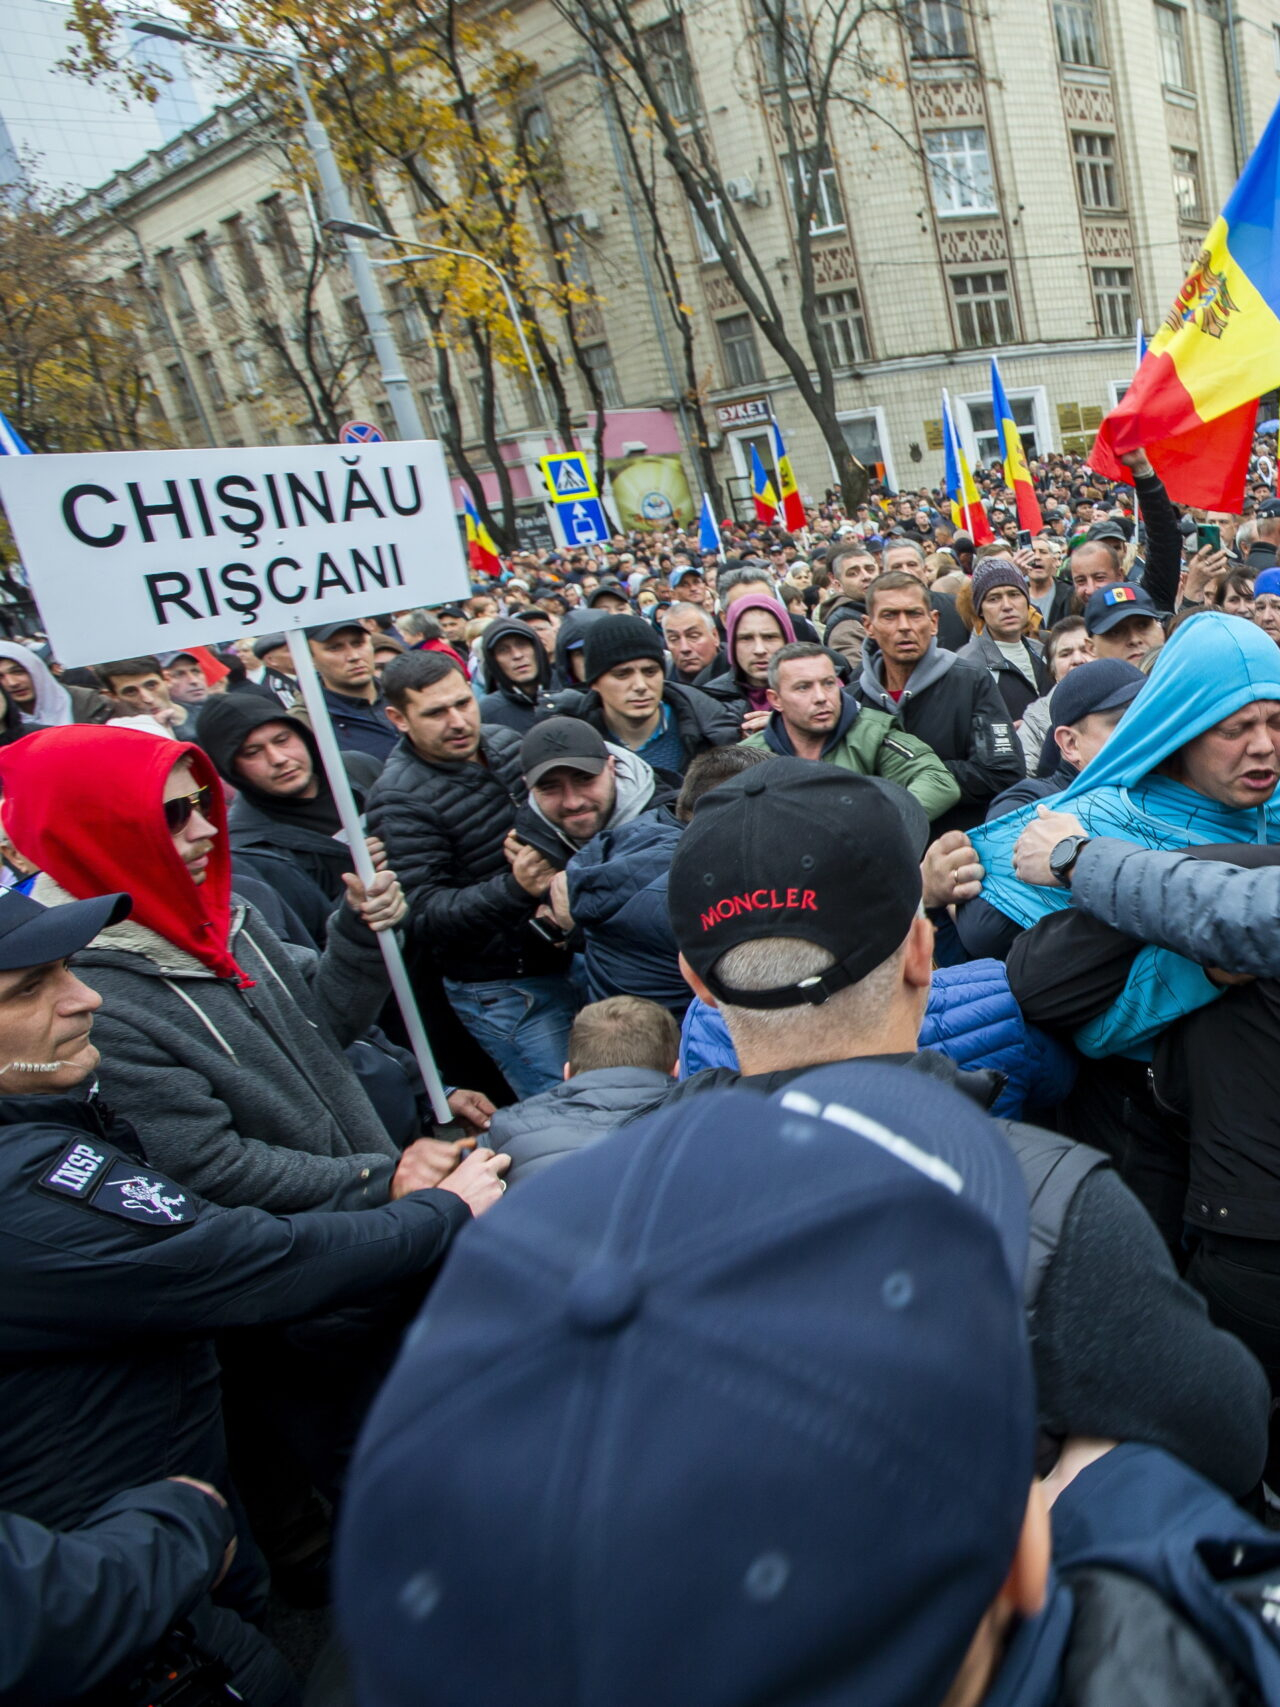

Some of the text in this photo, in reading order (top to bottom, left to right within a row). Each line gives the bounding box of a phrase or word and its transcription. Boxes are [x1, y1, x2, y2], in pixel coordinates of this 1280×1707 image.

[717, 400, 767, 421] БУКЕТ
[700, 887, 819, 932] MONCLER
[50, 1144, 104, 1191] INSP
